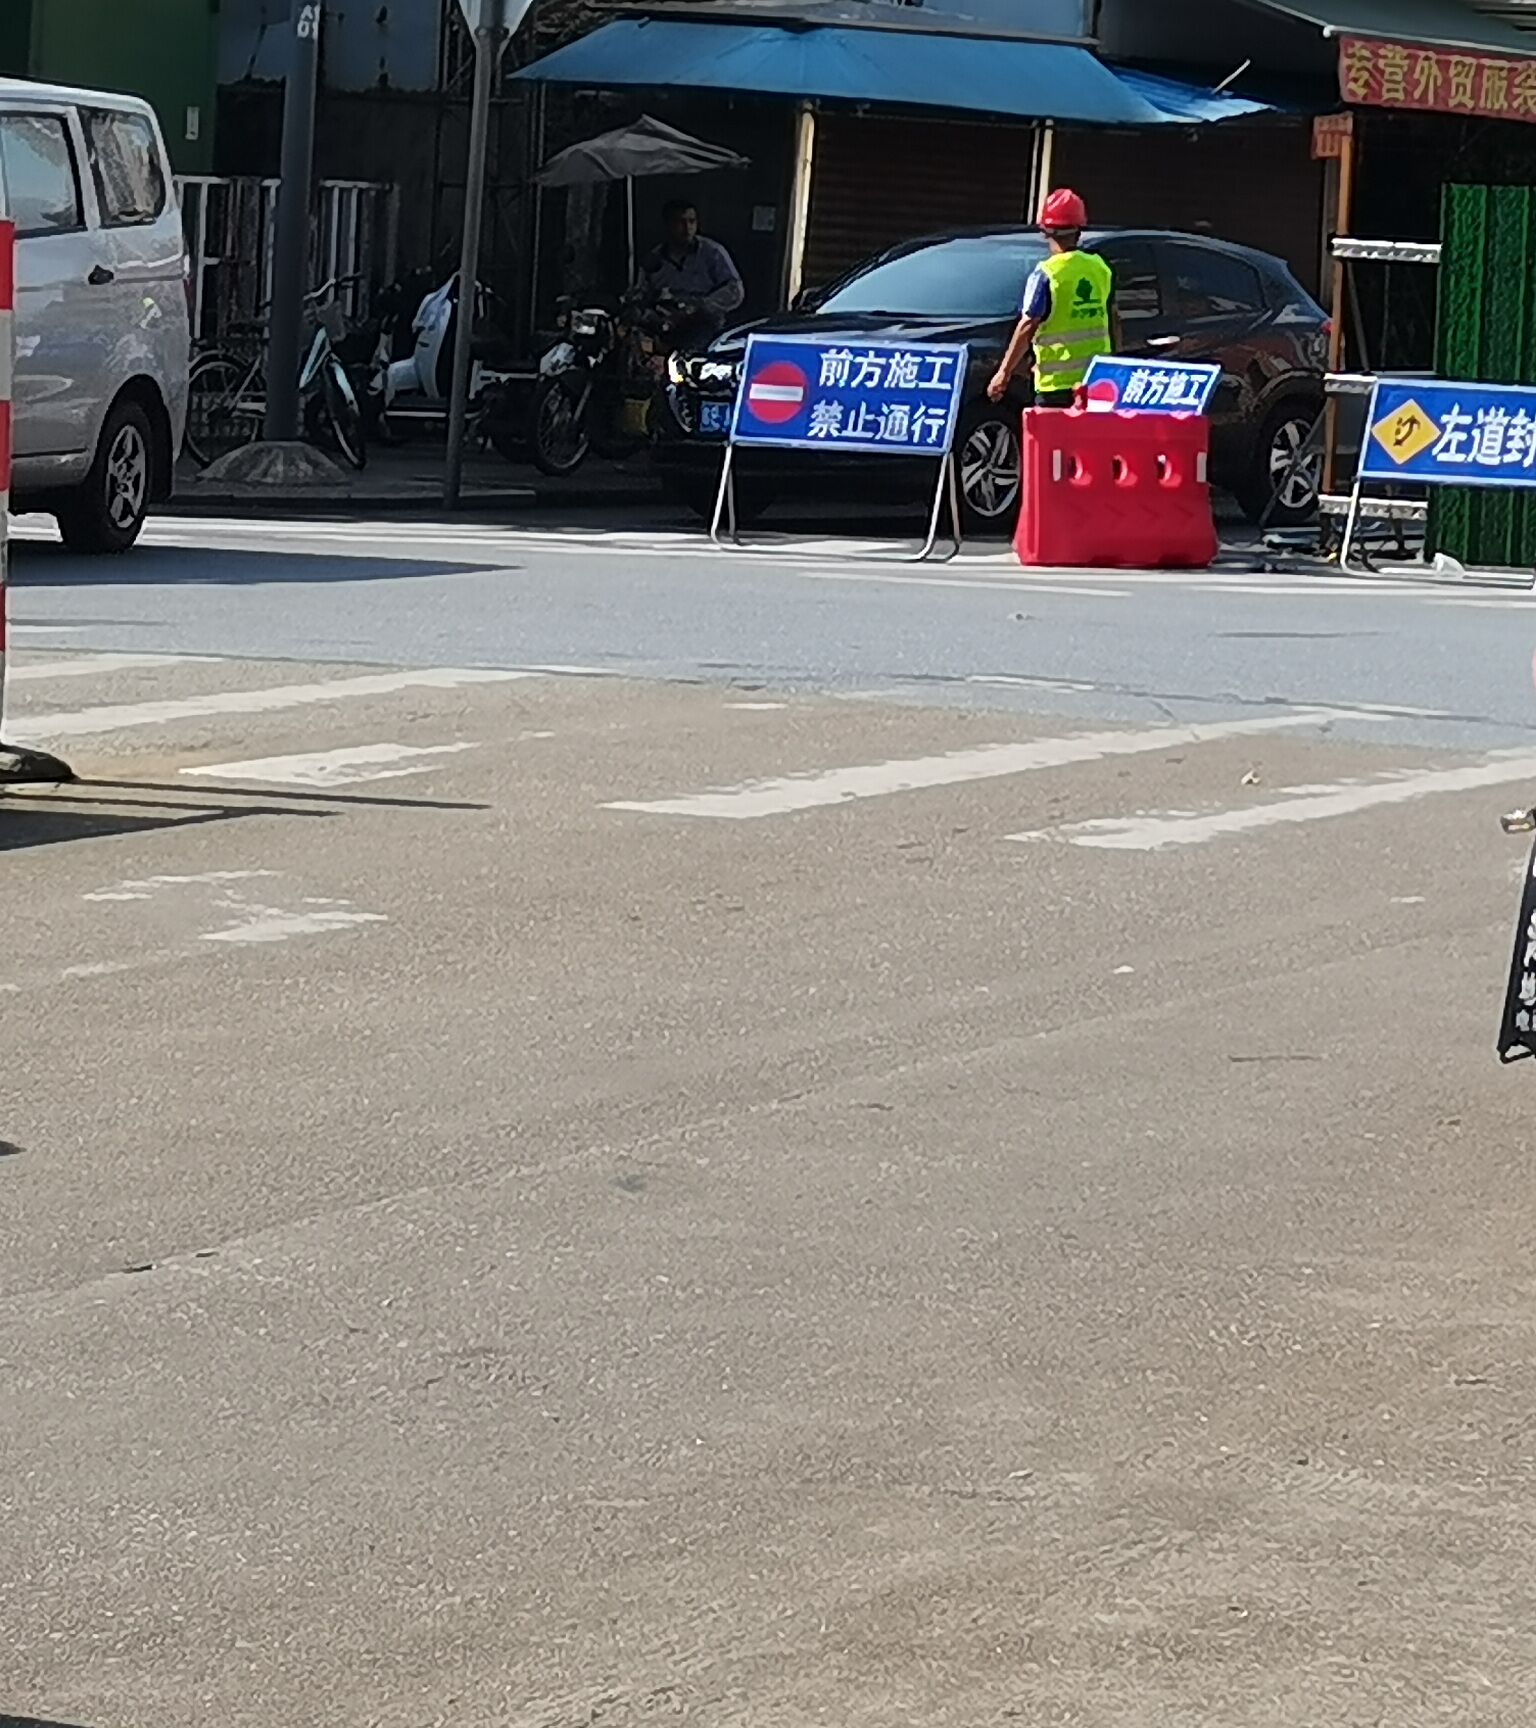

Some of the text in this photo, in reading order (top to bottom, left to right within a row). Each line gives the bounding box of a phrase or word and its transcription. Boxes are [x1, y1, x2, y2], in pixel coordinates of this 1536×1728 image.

[818, 348, 953, 390] 前方施工
[1121, 368, 1208, 405] 前方施工
[806, 402, 946, 444] 禁止通行
